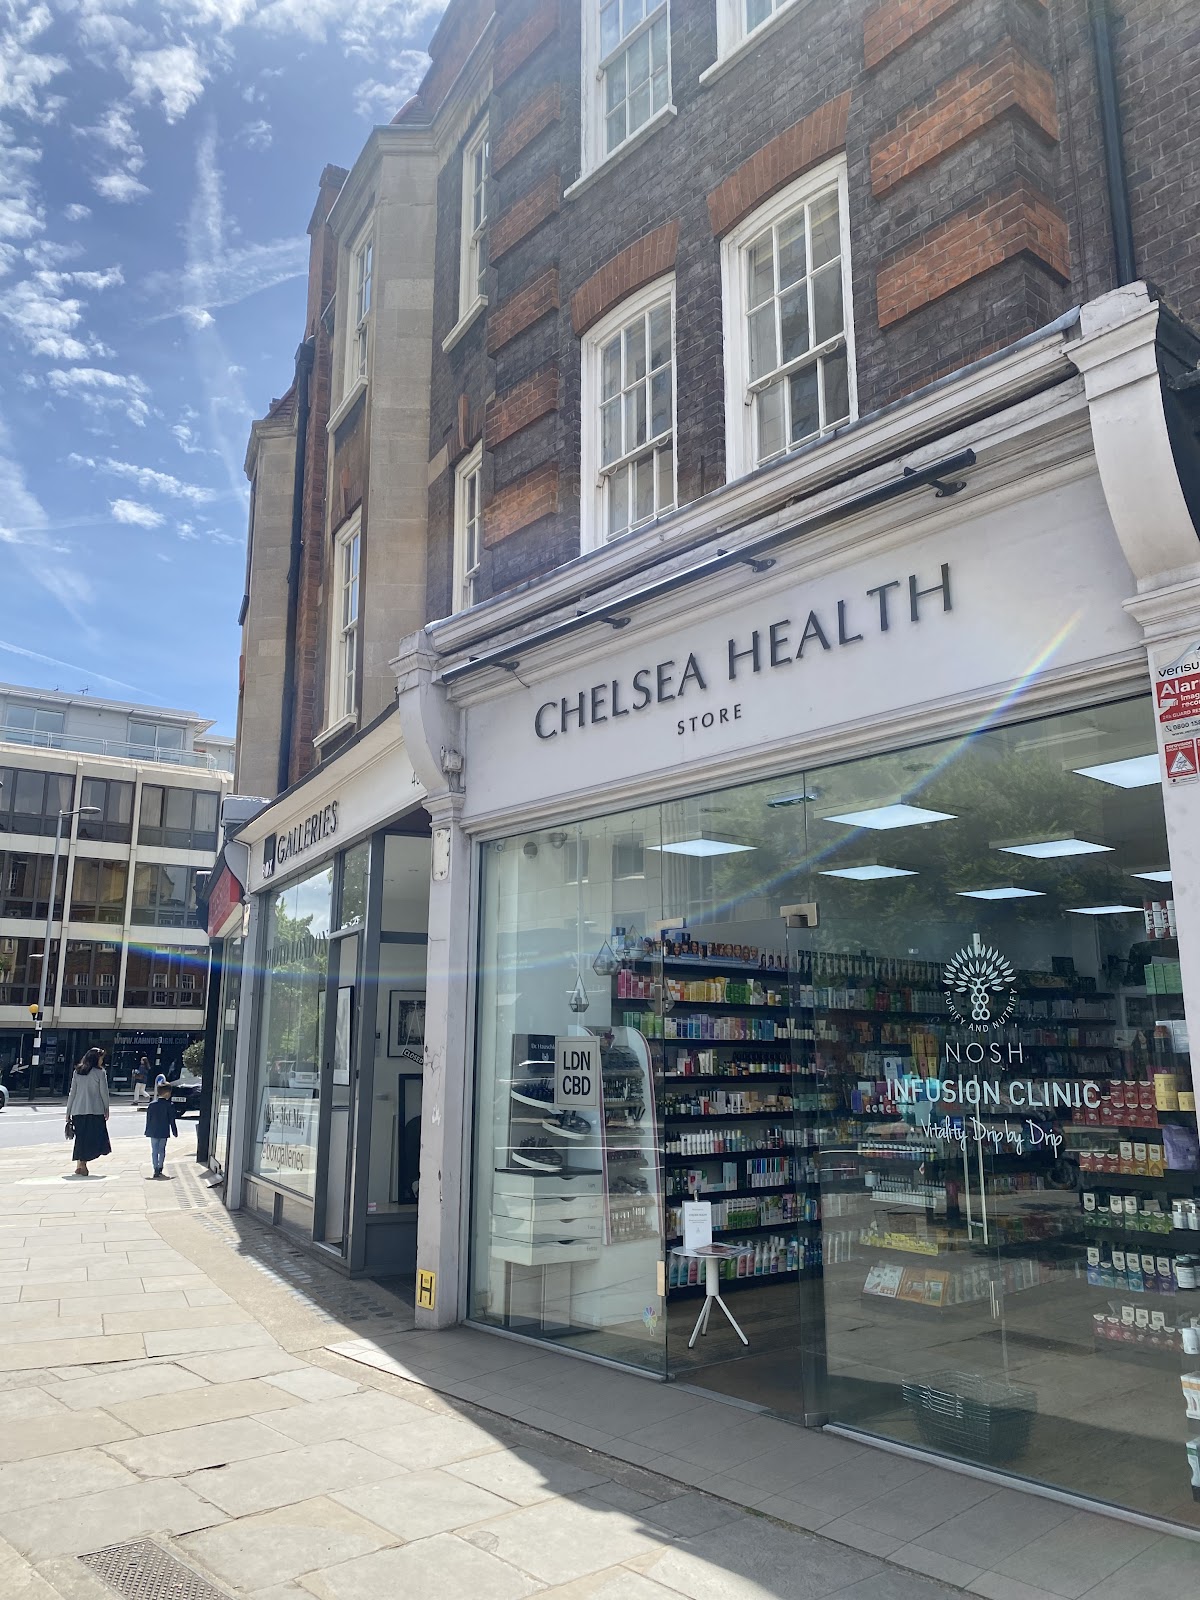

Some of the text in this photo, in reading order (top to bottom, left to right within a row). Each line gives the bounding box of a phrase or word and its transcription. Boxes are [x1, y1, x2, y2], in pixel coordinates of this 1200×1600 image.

[534, 562, 952, 740] CHELSEA HEALTH
[677, 703, 743, 736] STORE
[1172, 709, 1191, 718] GUARD
[1181, 699, 1200, 709] reco
[277, 800, 338, 864] GALLERIES
[944, 987, 1018, 1032] PURIFY AND NUTRIFY
[403, 1049, 424, 1064] CLOSED
[563, 1051, 591, 1071] LDN
[945, 1042, 1024, 1064] NOSH
[562, 1075, 591, 1096] CBD
[887, 1078, 1101, 1109] INFUSION CLINIC
[920, 1113, 1063, 1159] Vitality Drip by Drip
[420, 1273, 432, 1305] H
